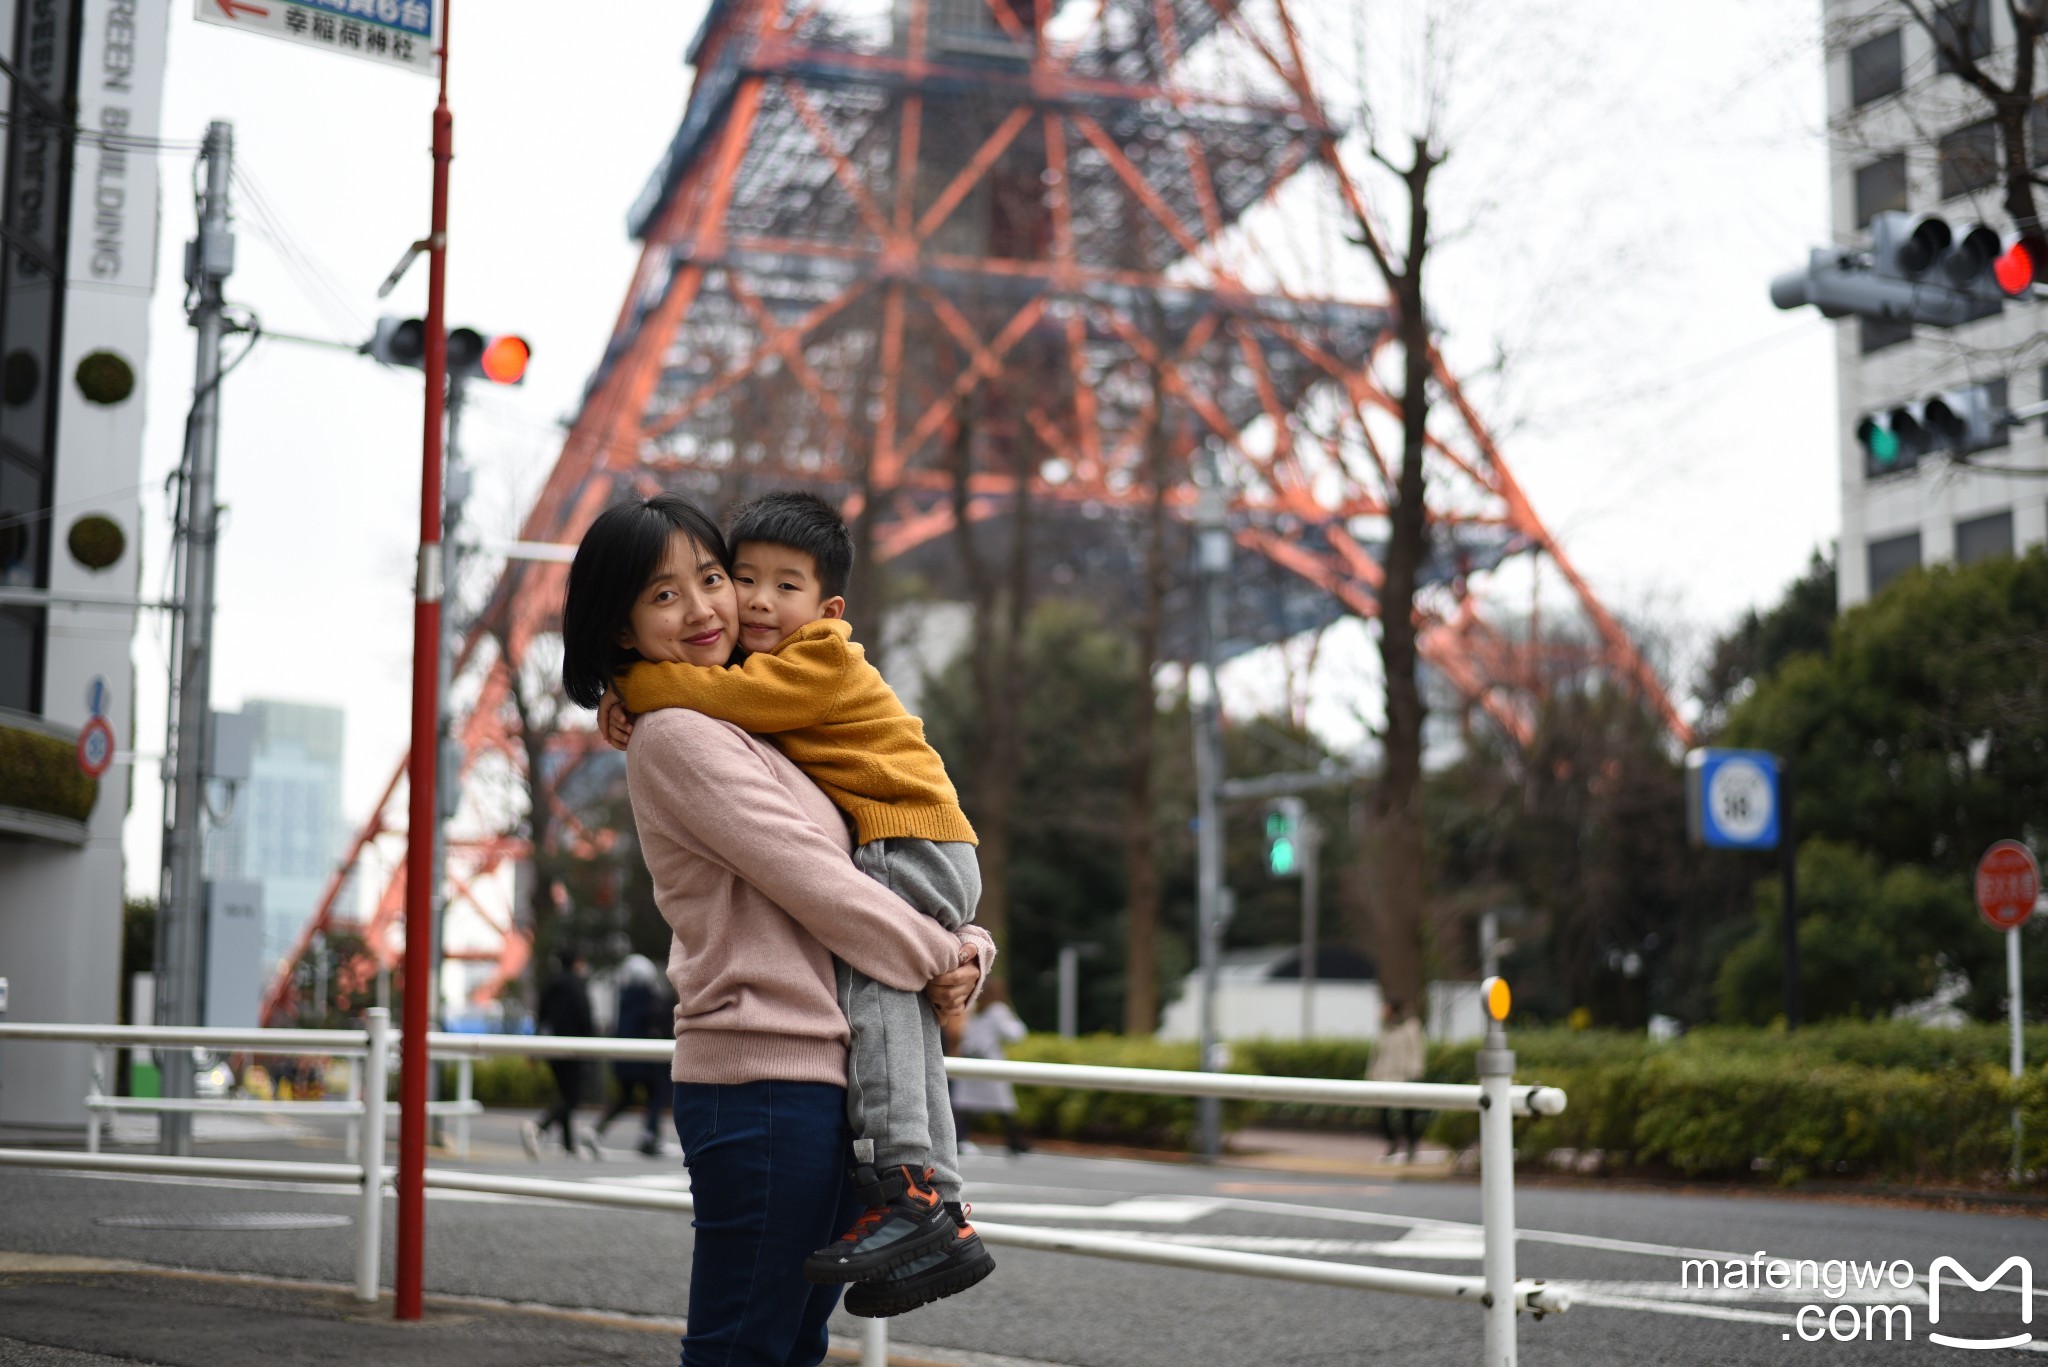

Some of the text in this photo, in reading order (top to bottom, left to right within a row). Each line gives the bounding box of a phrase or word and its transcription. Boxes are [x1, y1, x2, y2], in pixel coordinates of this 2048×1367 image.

[285, 5, 416, 63] 幸稲荷神社
